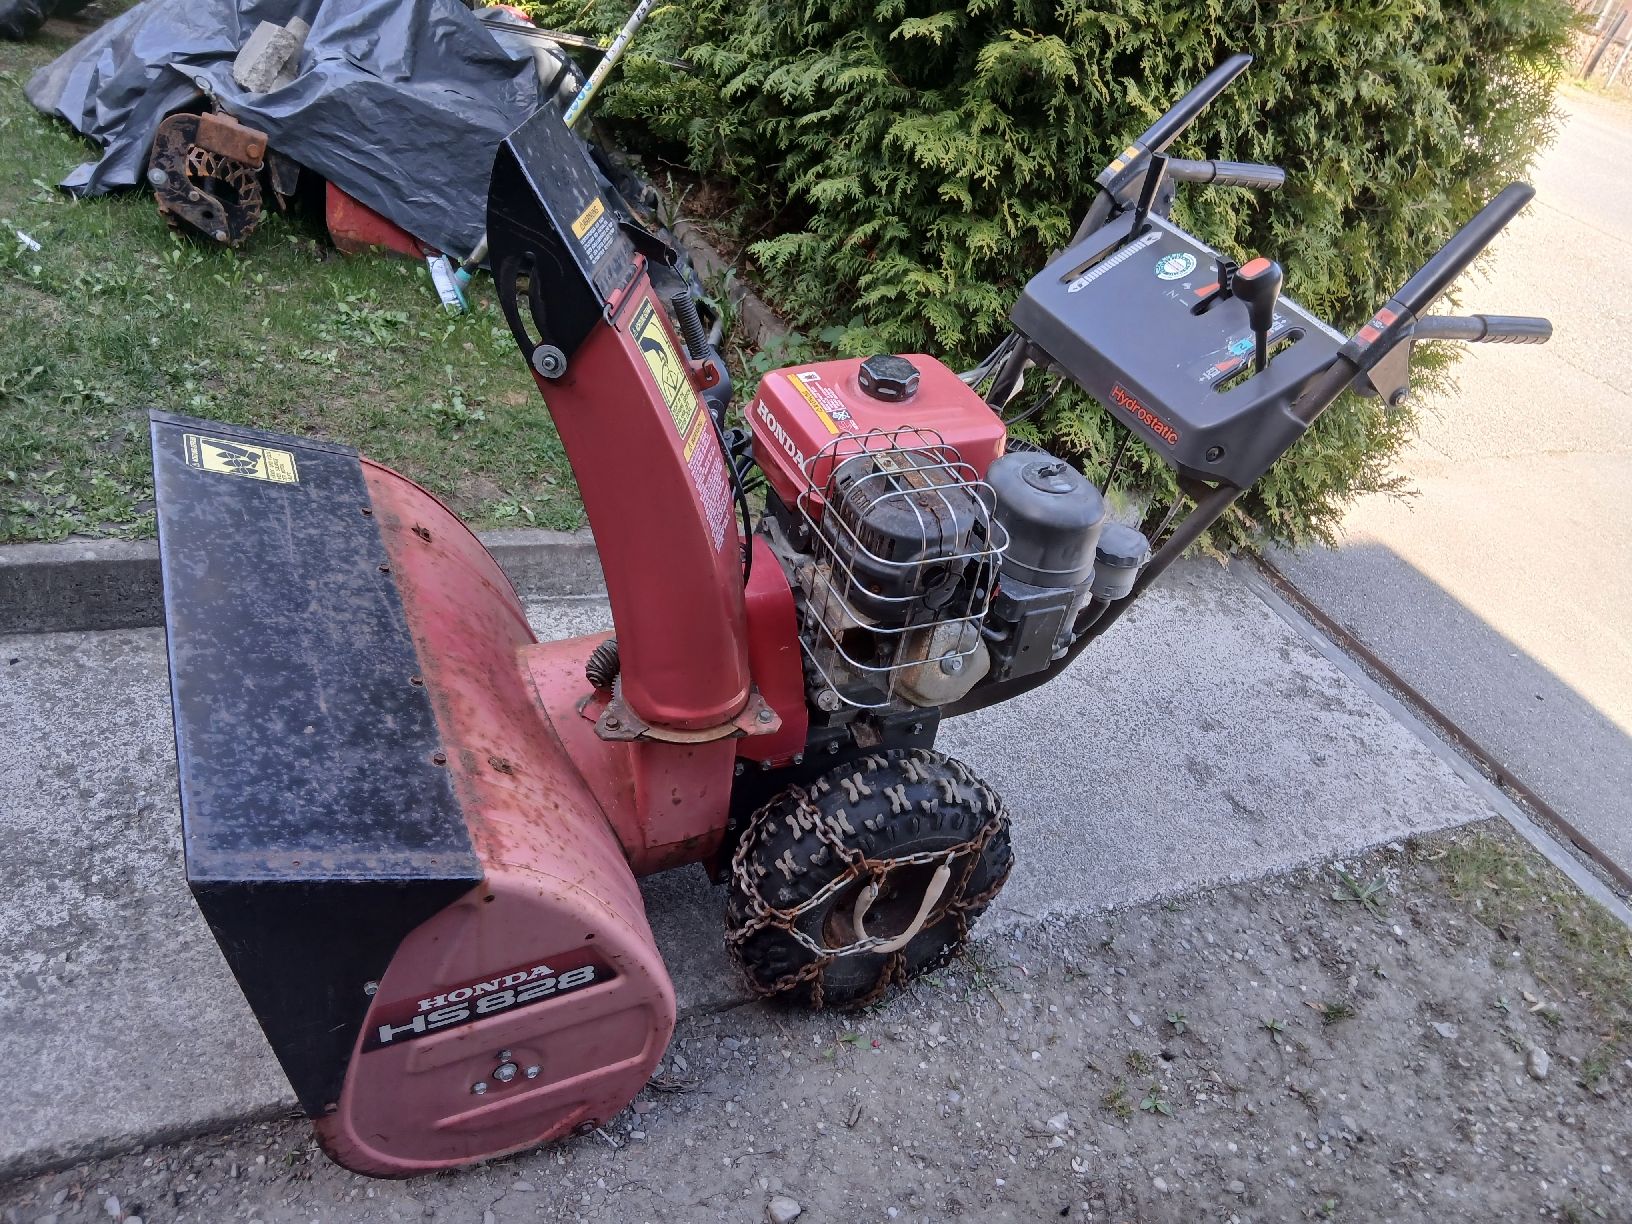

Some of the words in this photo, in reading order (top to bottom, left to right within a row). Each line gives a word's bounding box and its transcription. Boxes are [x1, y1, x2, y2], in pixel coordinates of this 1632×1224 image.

[757, 398, 806, 471] HONDA
[1112, 385, 1178, 445] Hydrostatic
[417, 964, 555, 1012] HONDA
